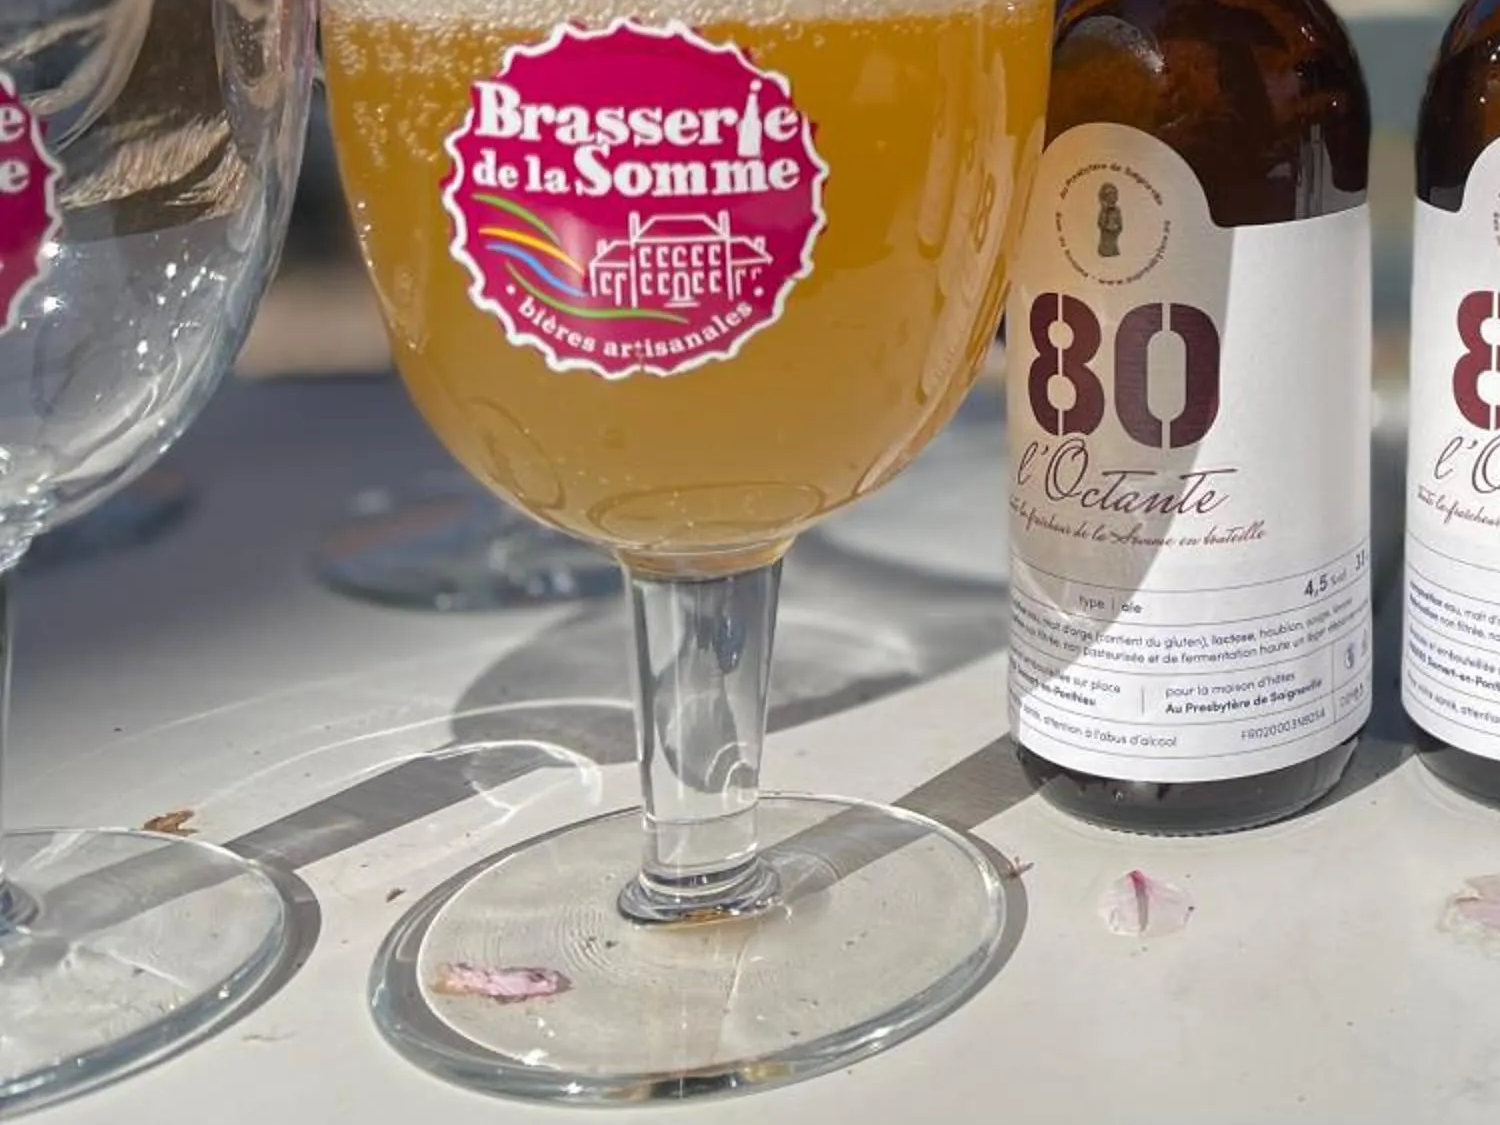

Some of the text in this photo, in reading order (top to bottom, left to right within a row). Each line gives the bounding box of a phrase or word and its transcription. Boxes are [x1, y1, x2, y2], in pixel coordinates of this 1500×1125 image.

[474, 80, 800, 158] Brasserie
[472, 143, 800, 197] de la Somme
[518, 296, 753, 359] bières artisanales
[1028, 293, 1220, 449] 80
[1018, 438, 1238, 514] l'Octante
[1304, 575, 1328, 597] 4,5
[1165, 703, 1181, 714] Au
[1185, 697, 1250, 714] Presbytère
[1254, 693, 1268, 704] de
